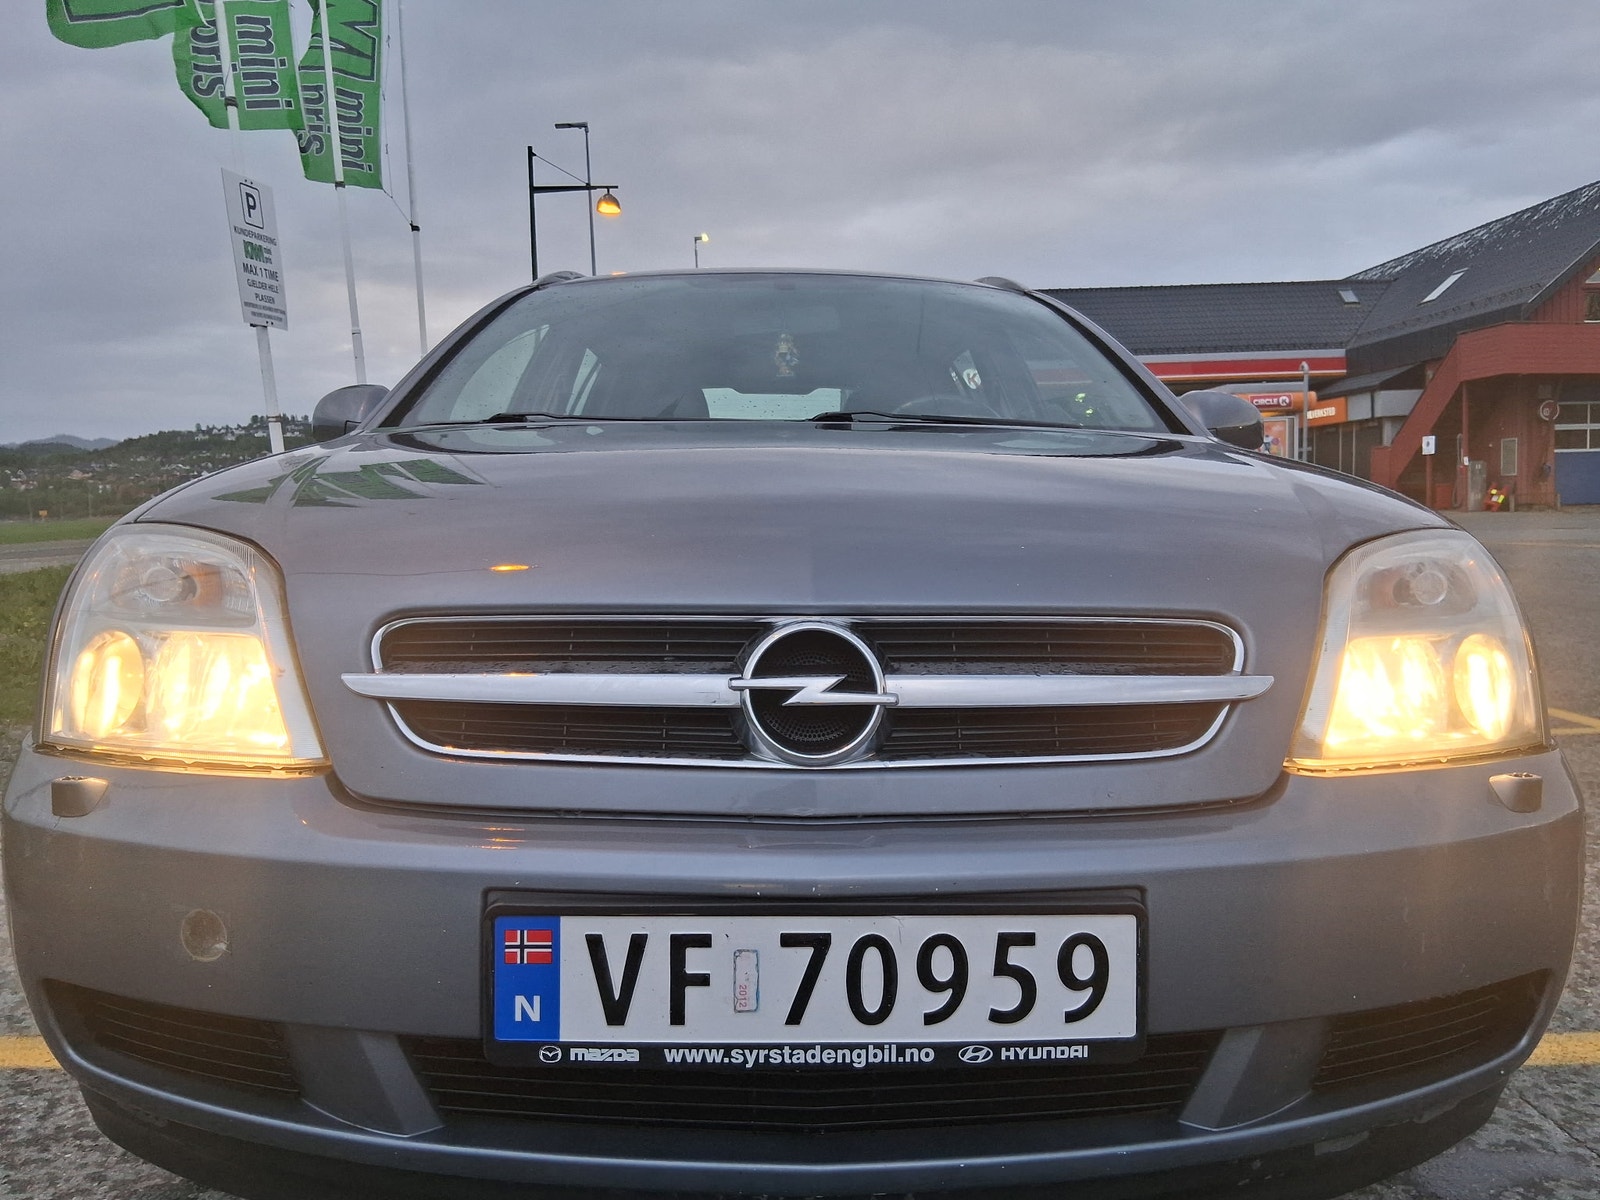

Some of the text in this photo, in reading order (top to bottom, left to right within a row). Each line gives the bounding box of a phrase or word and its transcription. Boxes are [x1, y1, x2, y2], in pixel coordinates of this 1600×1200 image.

[234, 14, 294, 110] mini
[334, 86, 374, 174] mini
[245, 191, 257, 218] P
[242, 262, 259, 276] MAX
[263, 268, 279, 282] TIME
[254, 292, 275, 304] PLASSEN
[1252, 396, 1289, 406] CIRCLE K
[585, 931, 1110, 1027] VF 70959
[514, 994, 541, 1022] N
[738, 984, 748, 1009] 2012
[663, 1044, 935, 1068] www.syrstadengbil.no
[1000, 1045, 1089, 1061] HYUNDAI
